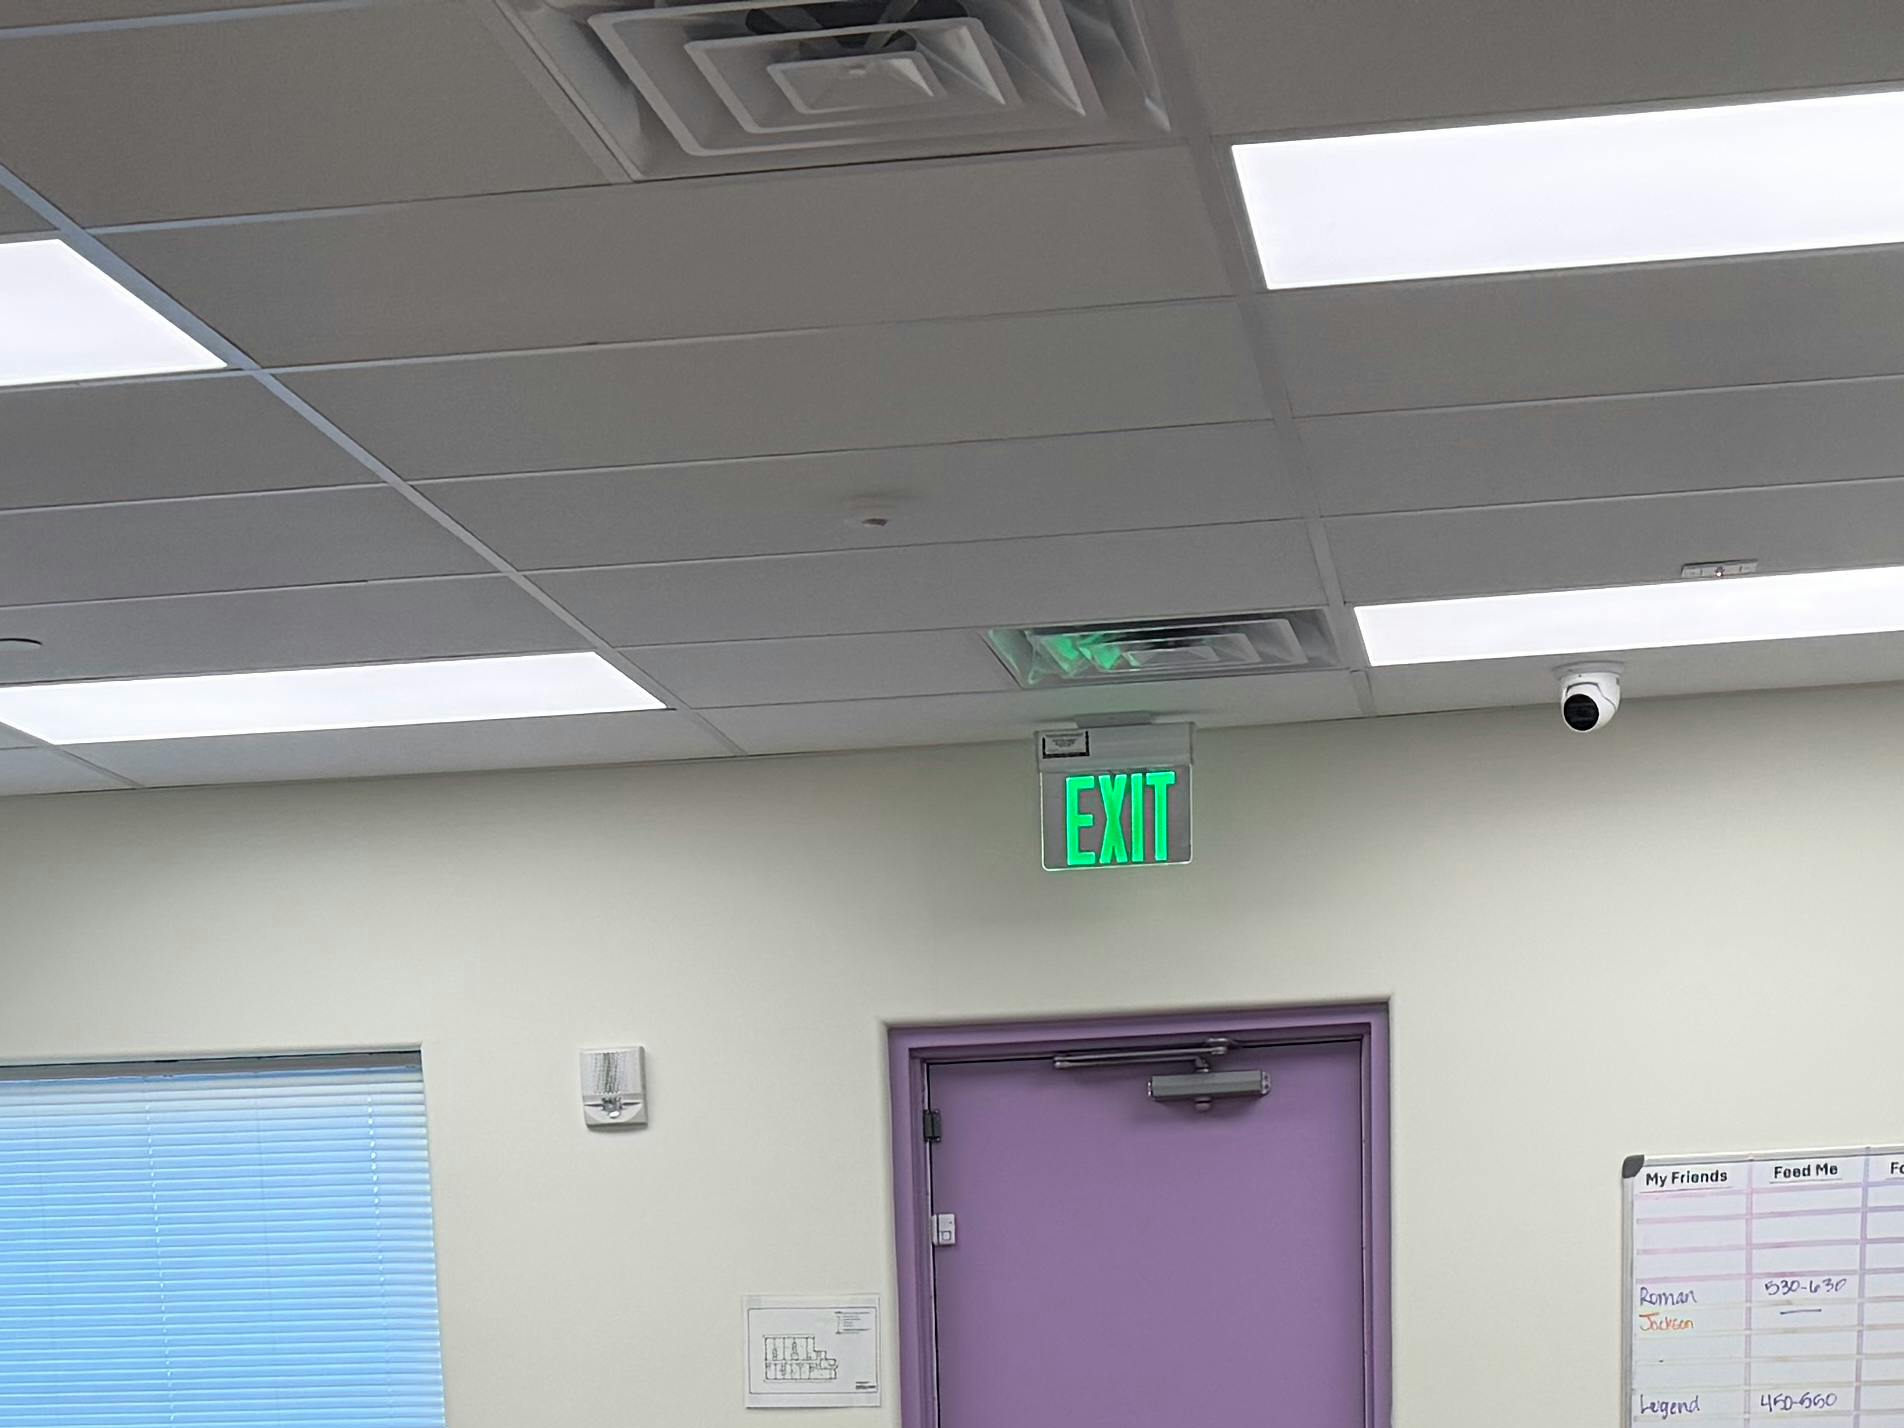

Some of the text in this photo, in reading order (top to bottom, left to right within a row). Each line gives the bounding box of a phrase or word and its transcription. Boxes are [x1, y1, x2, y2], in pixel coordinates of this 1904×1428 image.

[1066, 771, 1176, 866] EXIT
[1646, 1169, 1728, 1187] My Friends
[1774, 1162, 1838, 1179] Feed Me
[1640, 1286, 1698, 1306] Roman
[1764, 1278, 1847, 1296] 530-630
[1639, 1312, 1694, 1331] Jackson
[1641, 1394, 1700, 1420] Legend
